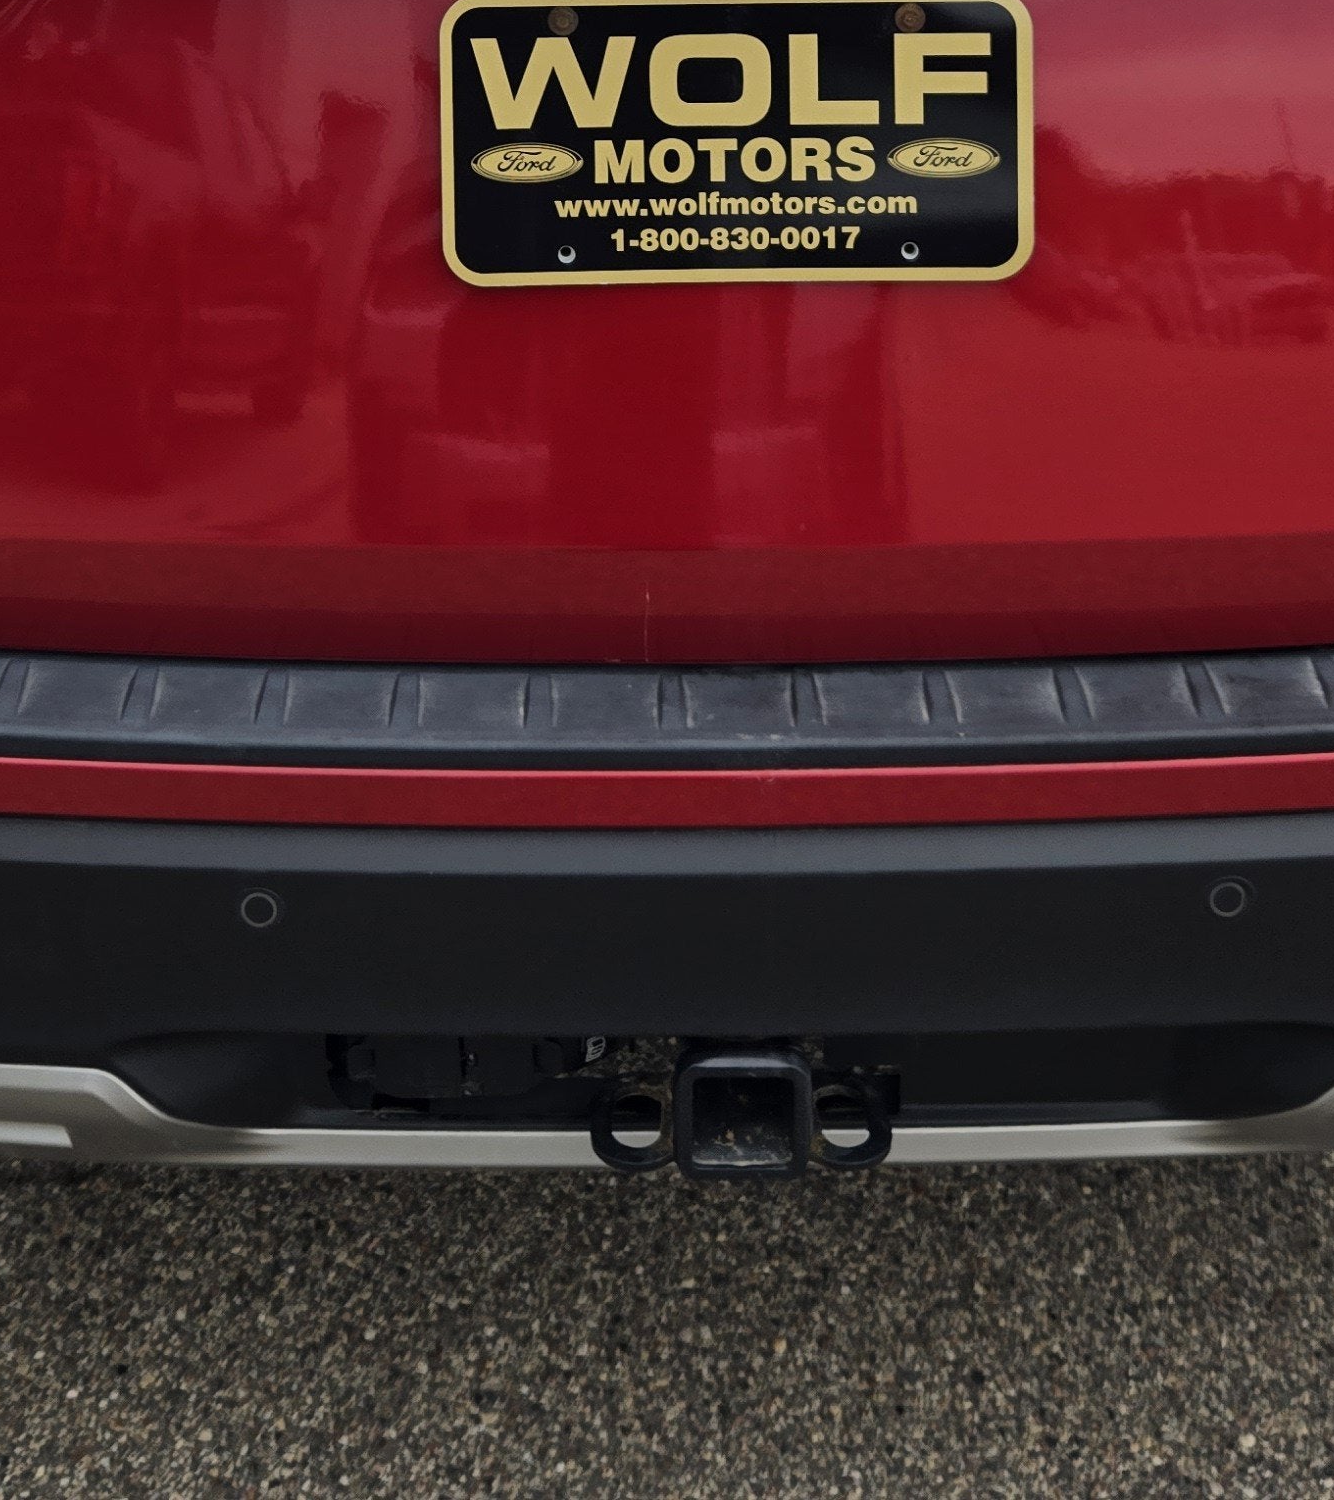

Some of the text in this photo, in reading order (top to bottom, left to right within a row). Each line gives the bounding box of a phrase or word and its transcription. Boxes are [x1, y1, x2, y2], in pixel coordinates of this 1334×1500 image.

[469, 32, 992, 130] WOLF
[497, 149, 556, 173] Ford
[593, 135, 877, 185] MOTORS
[912, 144, 973, 168] Ford
[554, 190, 918, 218] www.wolfmotors.com
[610, 225, 861, 252] 1-800-830-0017
